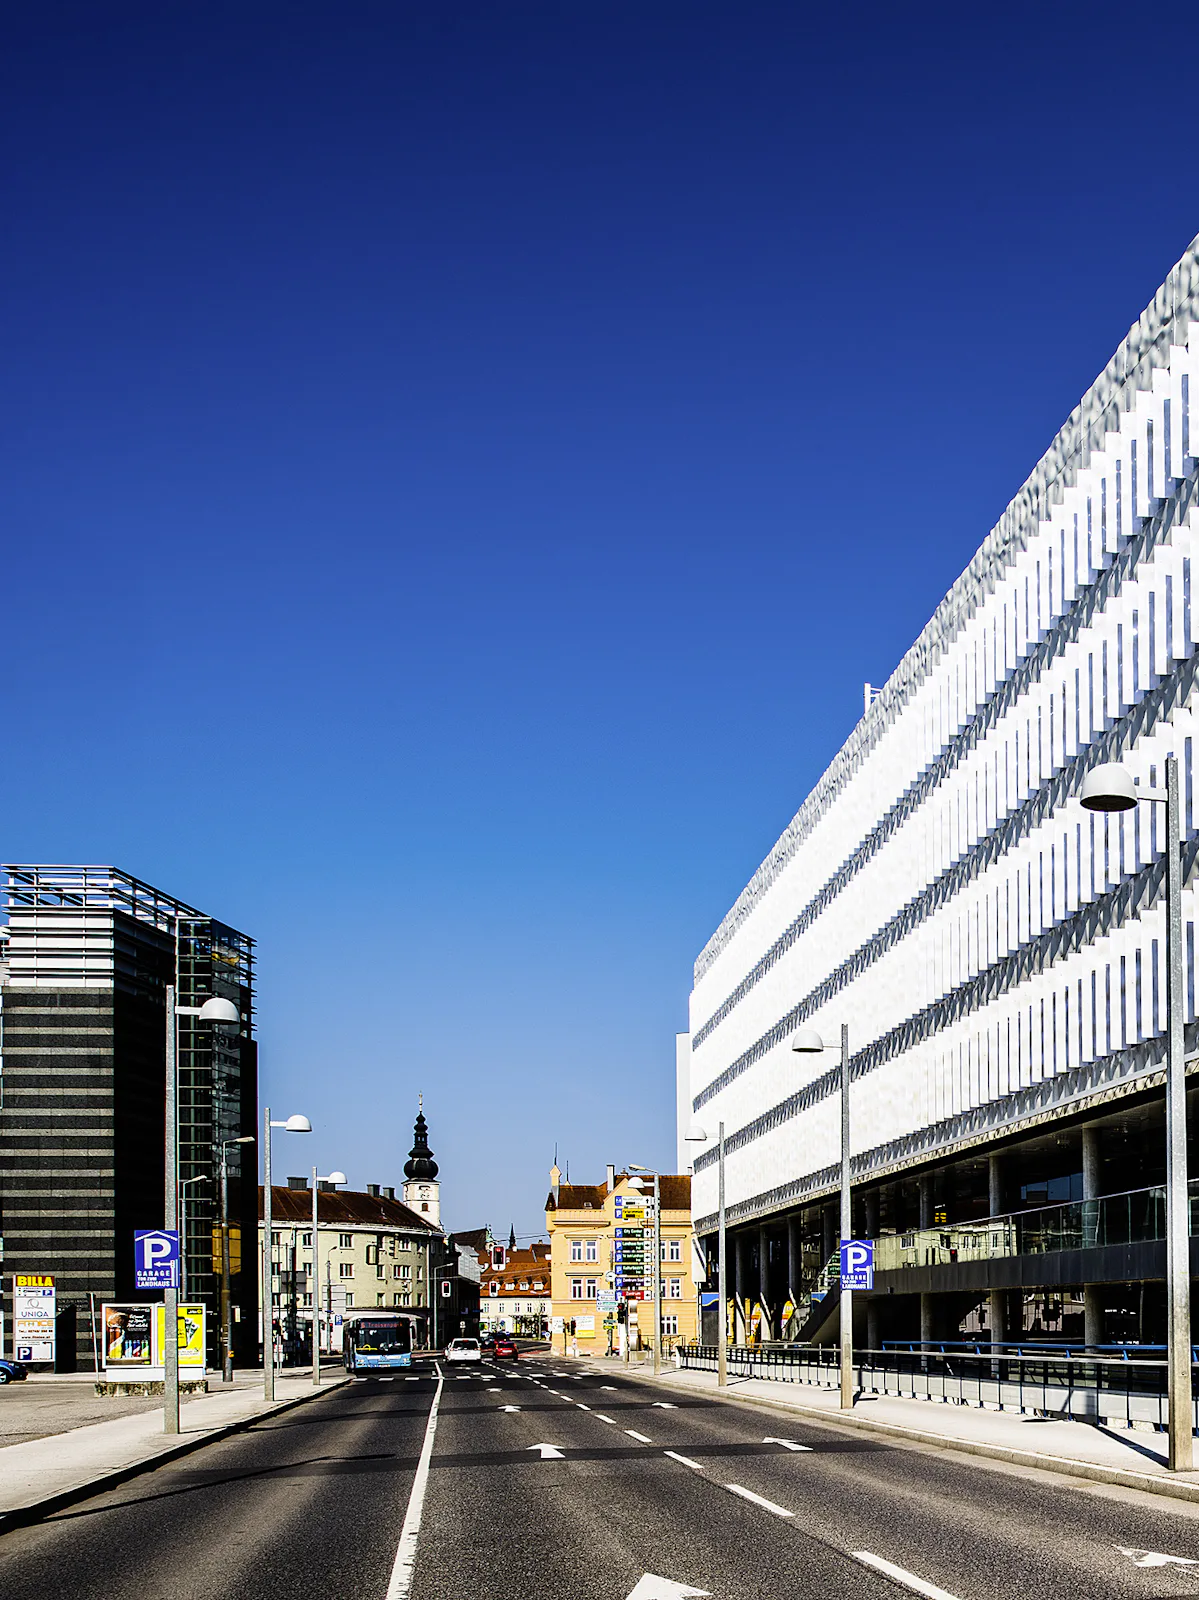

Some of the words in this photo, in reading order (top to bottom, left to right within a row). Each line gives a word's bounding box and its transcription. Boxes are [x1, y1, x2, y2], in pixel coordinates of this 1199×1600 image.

[144, 1238, 172, 1269] P
[847, 1246, 868, 1274] P
[17, 1275, 54, 1287] BILLA
[19, 1347, 30, 1360] P
